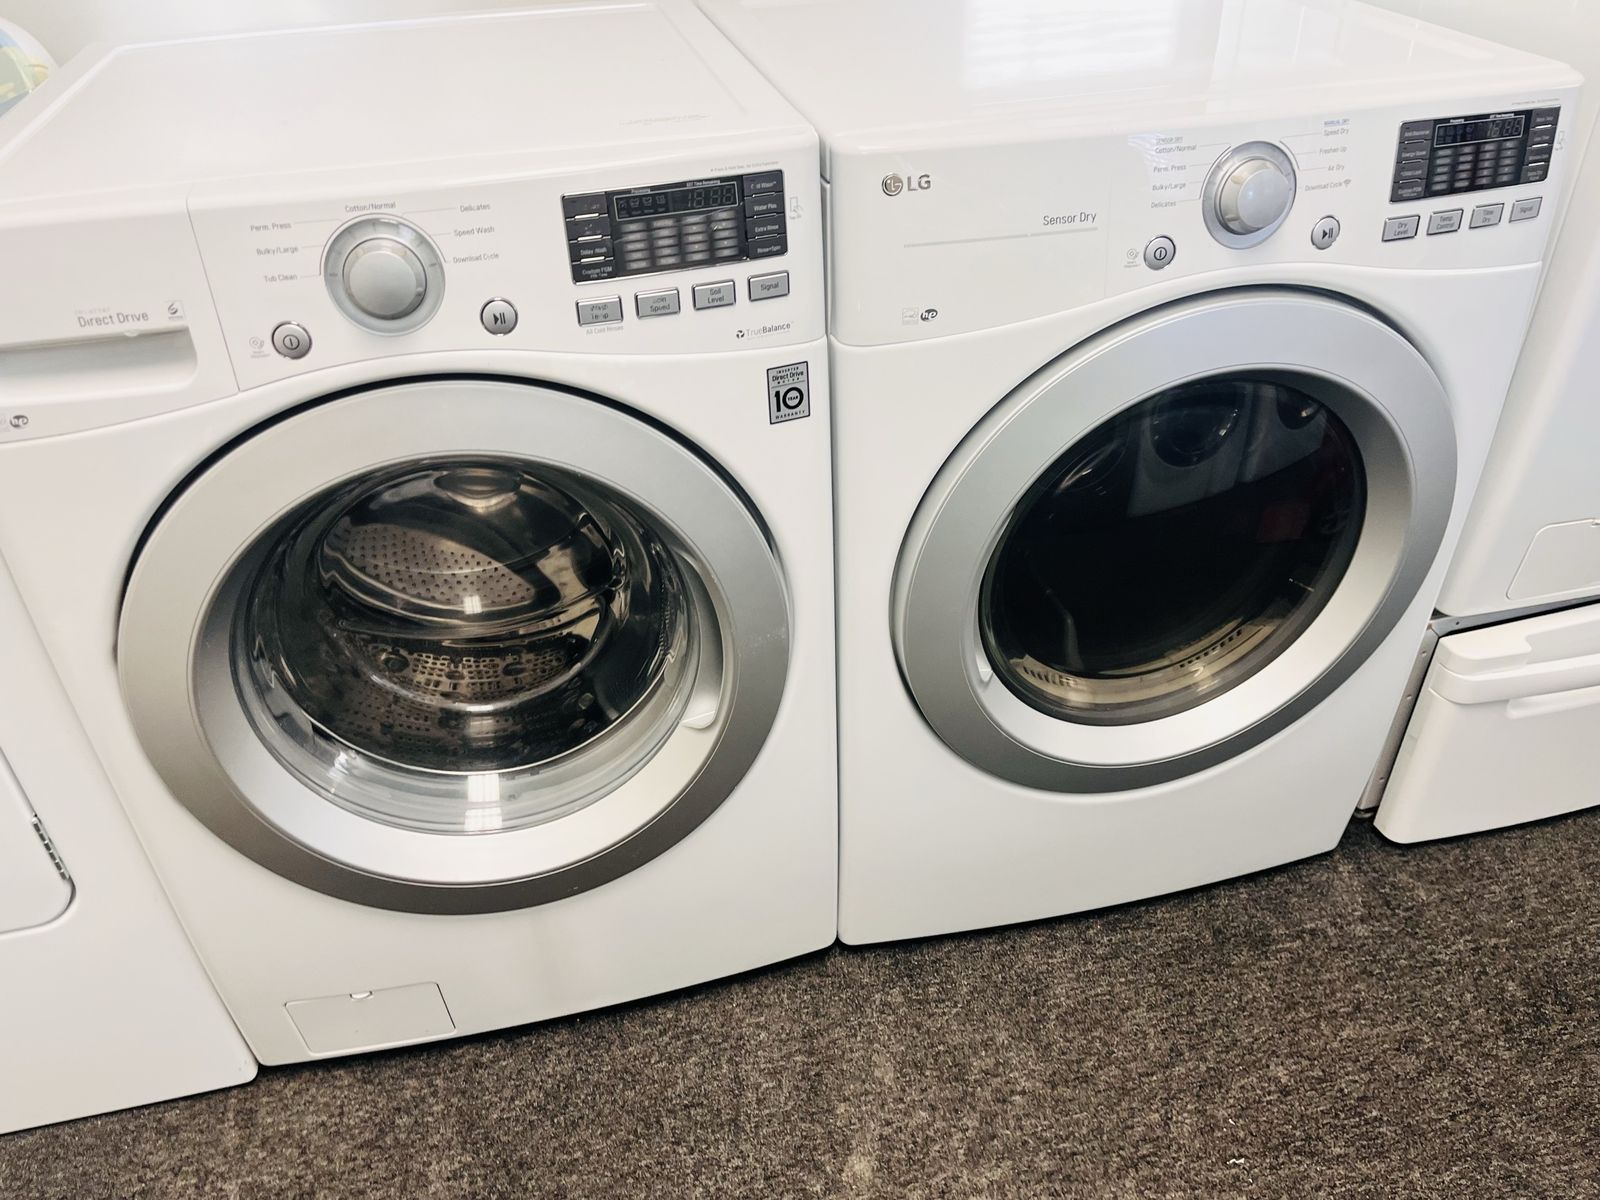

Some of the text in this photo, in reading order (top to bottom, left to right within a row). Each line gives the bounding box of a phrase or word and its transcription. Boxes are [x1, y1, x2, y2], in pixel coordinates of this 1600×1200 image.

[907, 174, 931, 191] LG
[344, 201, 396, 213] Cotton/Normal
[460, 204, 491, 212] Delicates
[1150, 201, 1176, 209] Delicates
[1042, 211, 1096, 226] Sensor Dry
[250, 222, 292, 232] Perm. Press
[454, 228, 475, 238] Speed
[256, 246, 299, 257] Bulky/Large
[264, 274, 298, 283] Tub Clean
[760, 281, 779, 291] Signal
[708, 296, 725, 304] Level
[77, 312, 149, 328] Direct Drive
[746, 322, 791, 337] TrueBalance
[772, 370, 804, 382] Direct Drive
[774, 386, 804, 412] 10
[776, 410, 805, 420] WARRANTY
